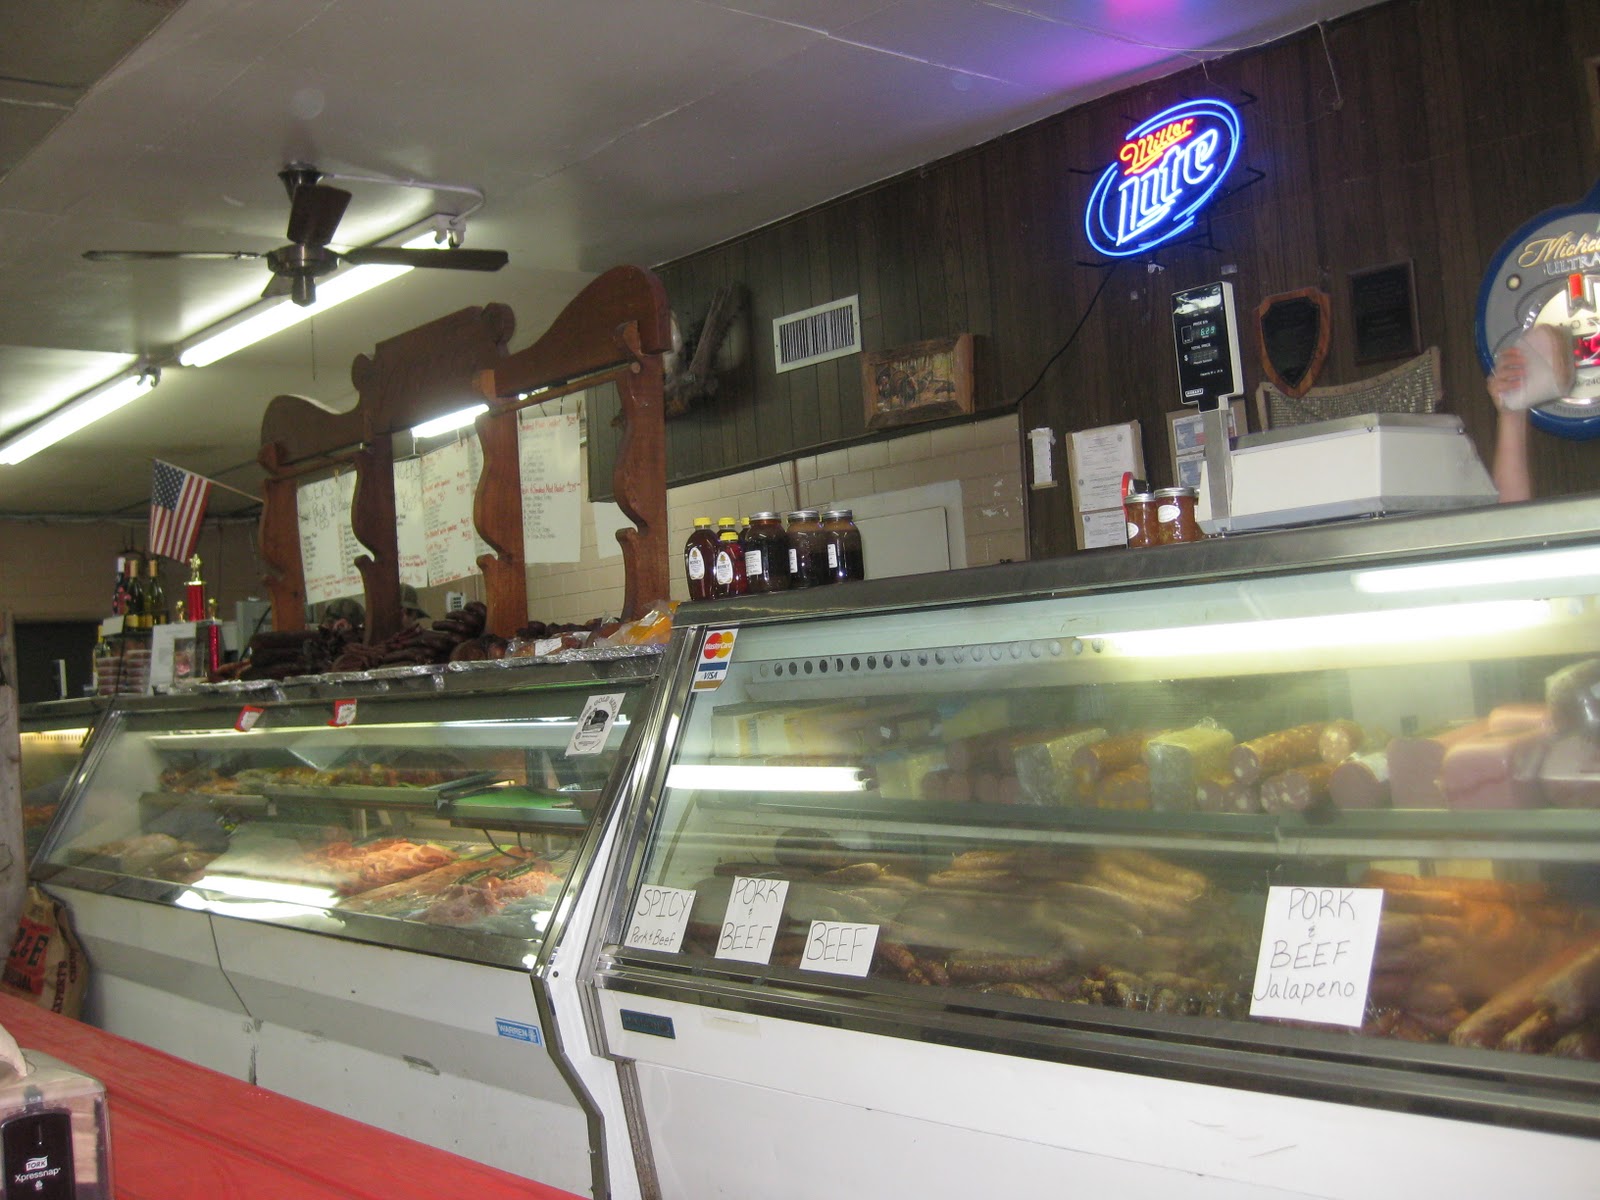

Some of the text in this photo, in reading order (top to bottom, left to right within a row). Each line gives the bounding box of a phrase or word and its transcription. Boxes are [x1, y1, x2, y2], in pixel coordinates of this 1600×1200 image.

[1119, 118, 1194, 173] Miller
[1115, 128, 1218, 246] Lite
[705, 642, 733, 650] MasterCard
[703, 671, 718, 680] VISA
[637, 888, 692, 923] SPICY
[732, 877, 781, 906] PORK
[1288, 887, 1355, 921] PORK
[630, 925, 648, 944] Pork
[652, 928, 676, 947] Beef
[719, 921, 773, 951] BEEF
[805, 921, 867, 962] BEEF
[1270, 939, 1350, 970] BEEF
[1253, 973, 1355, 1006] Jalapeno
[26, 1160, 46, 1169] TORK
